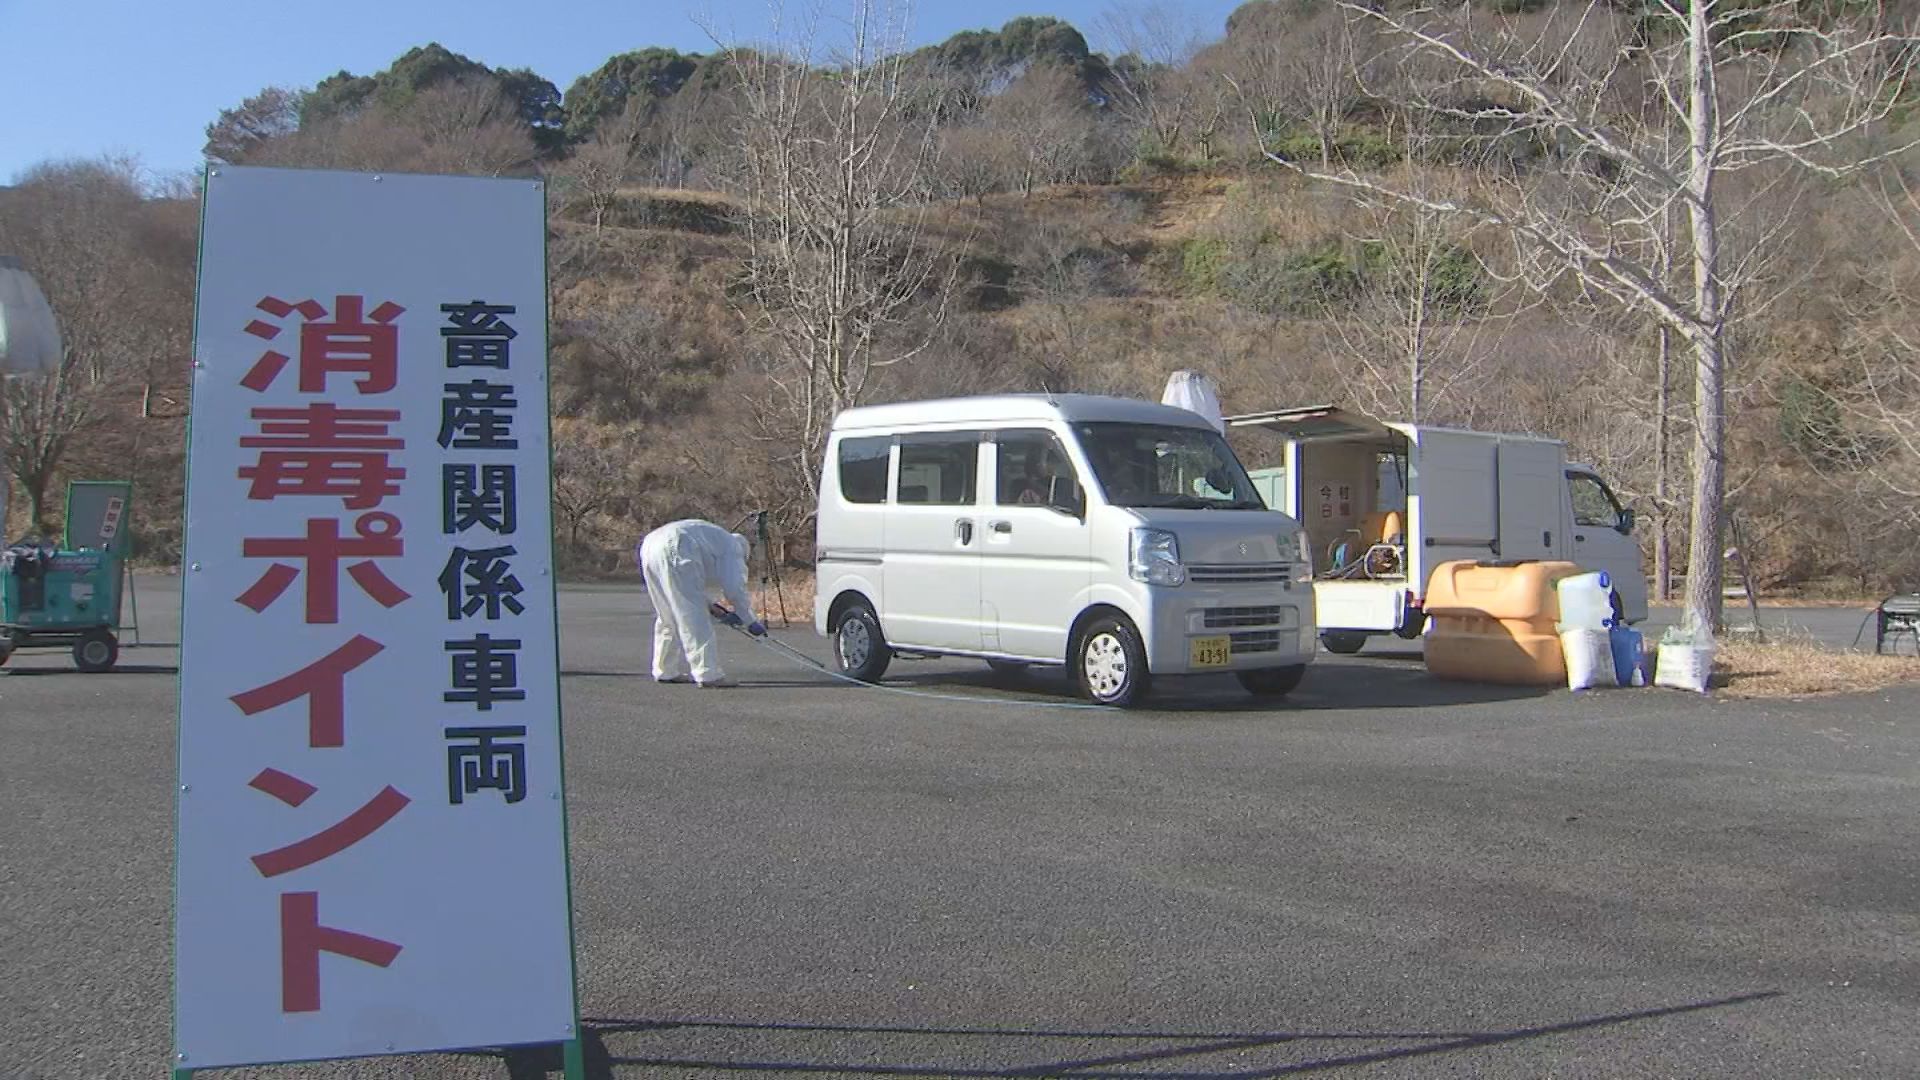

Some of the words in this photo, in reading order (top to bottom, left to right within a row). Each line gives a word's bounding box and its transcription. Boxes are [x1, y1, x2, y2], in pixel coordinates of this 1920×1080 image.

[228, 295, 412, 1013] 消毒ポイント
[437, 300, 526, 804] 畜産関係車両
